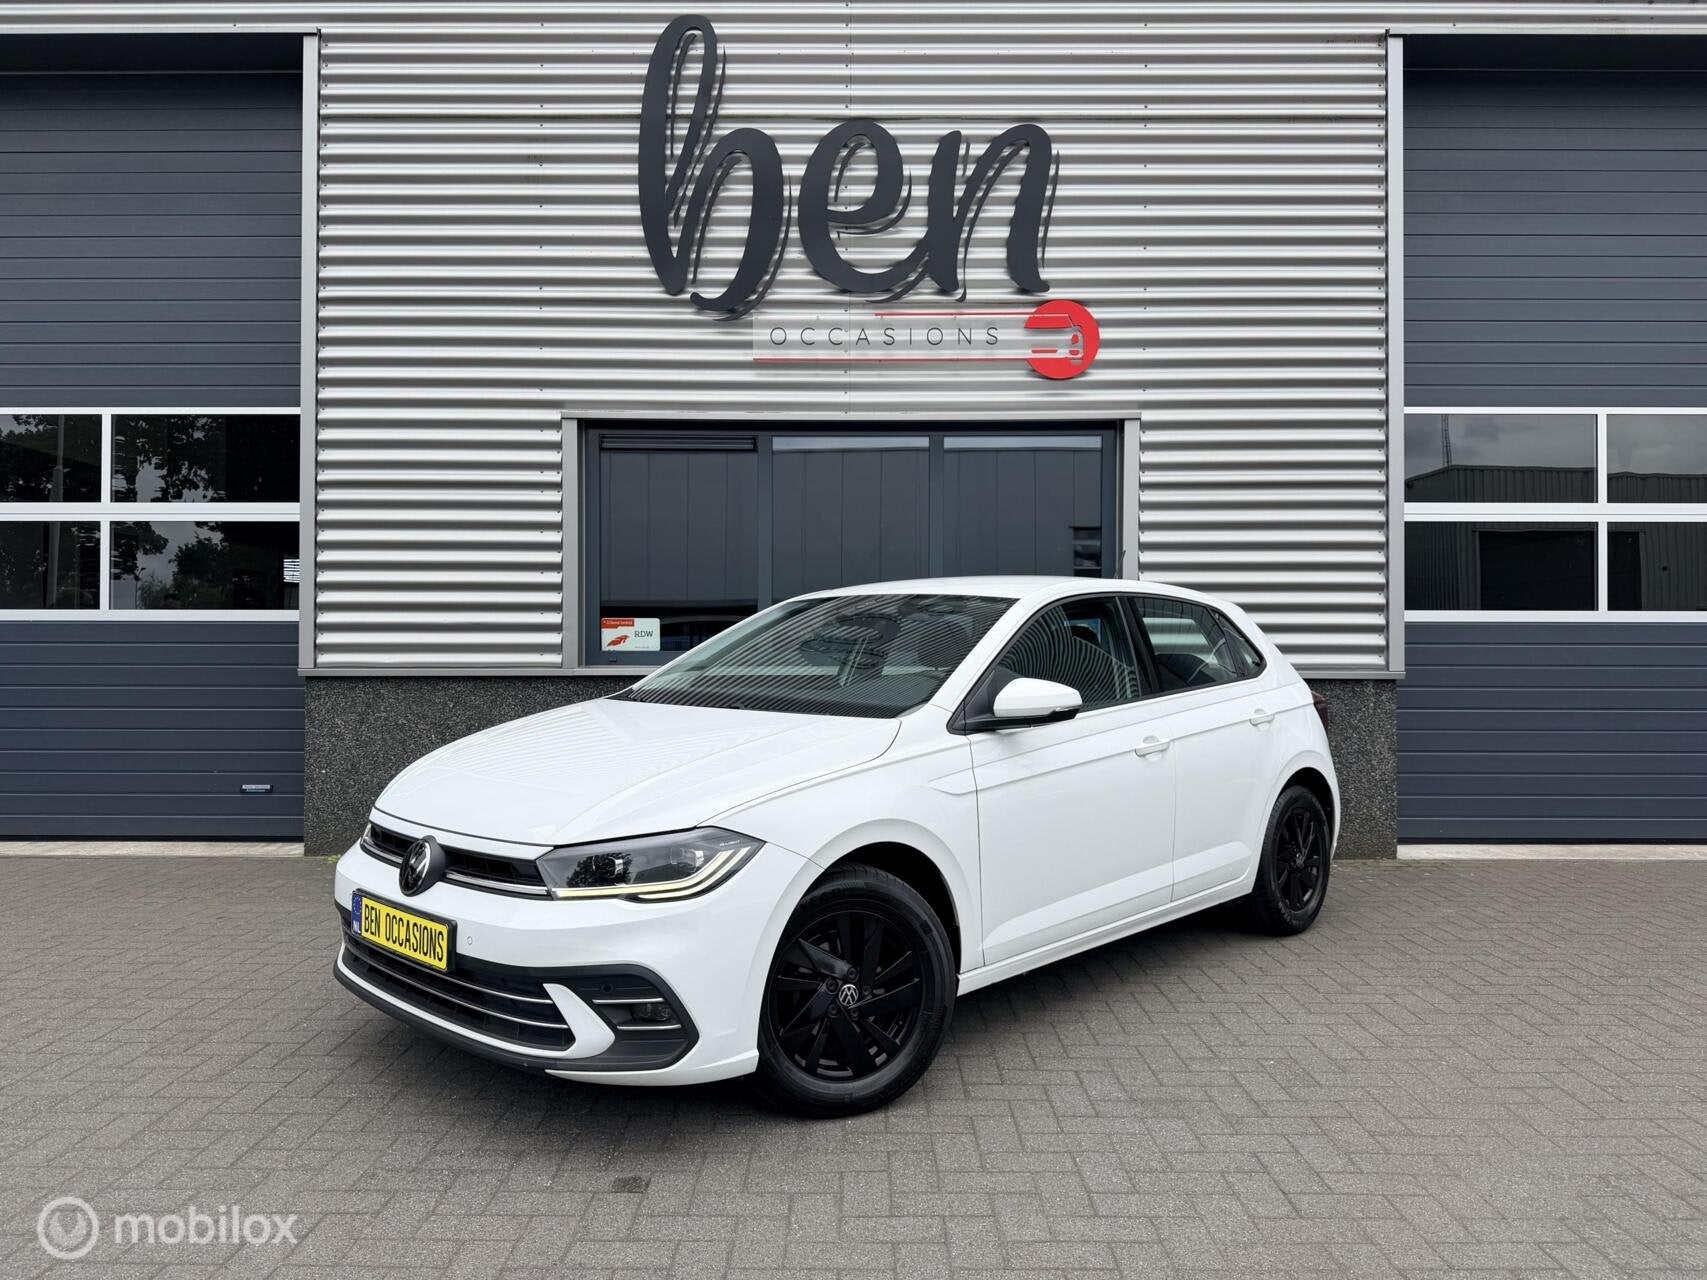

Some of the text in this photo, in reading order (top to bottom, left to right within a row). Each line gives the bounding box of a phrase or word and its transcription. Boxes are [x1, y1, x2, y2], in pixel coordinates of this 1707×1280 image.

[638, 14, 1058, 318] ben
[769, 326, 999, 346] OCCASIONS
[634, 630, 654, 638] RDW
[353, 919, 361, 934] NL
[364, 903, 444, 962] BEN OCCASIONS
